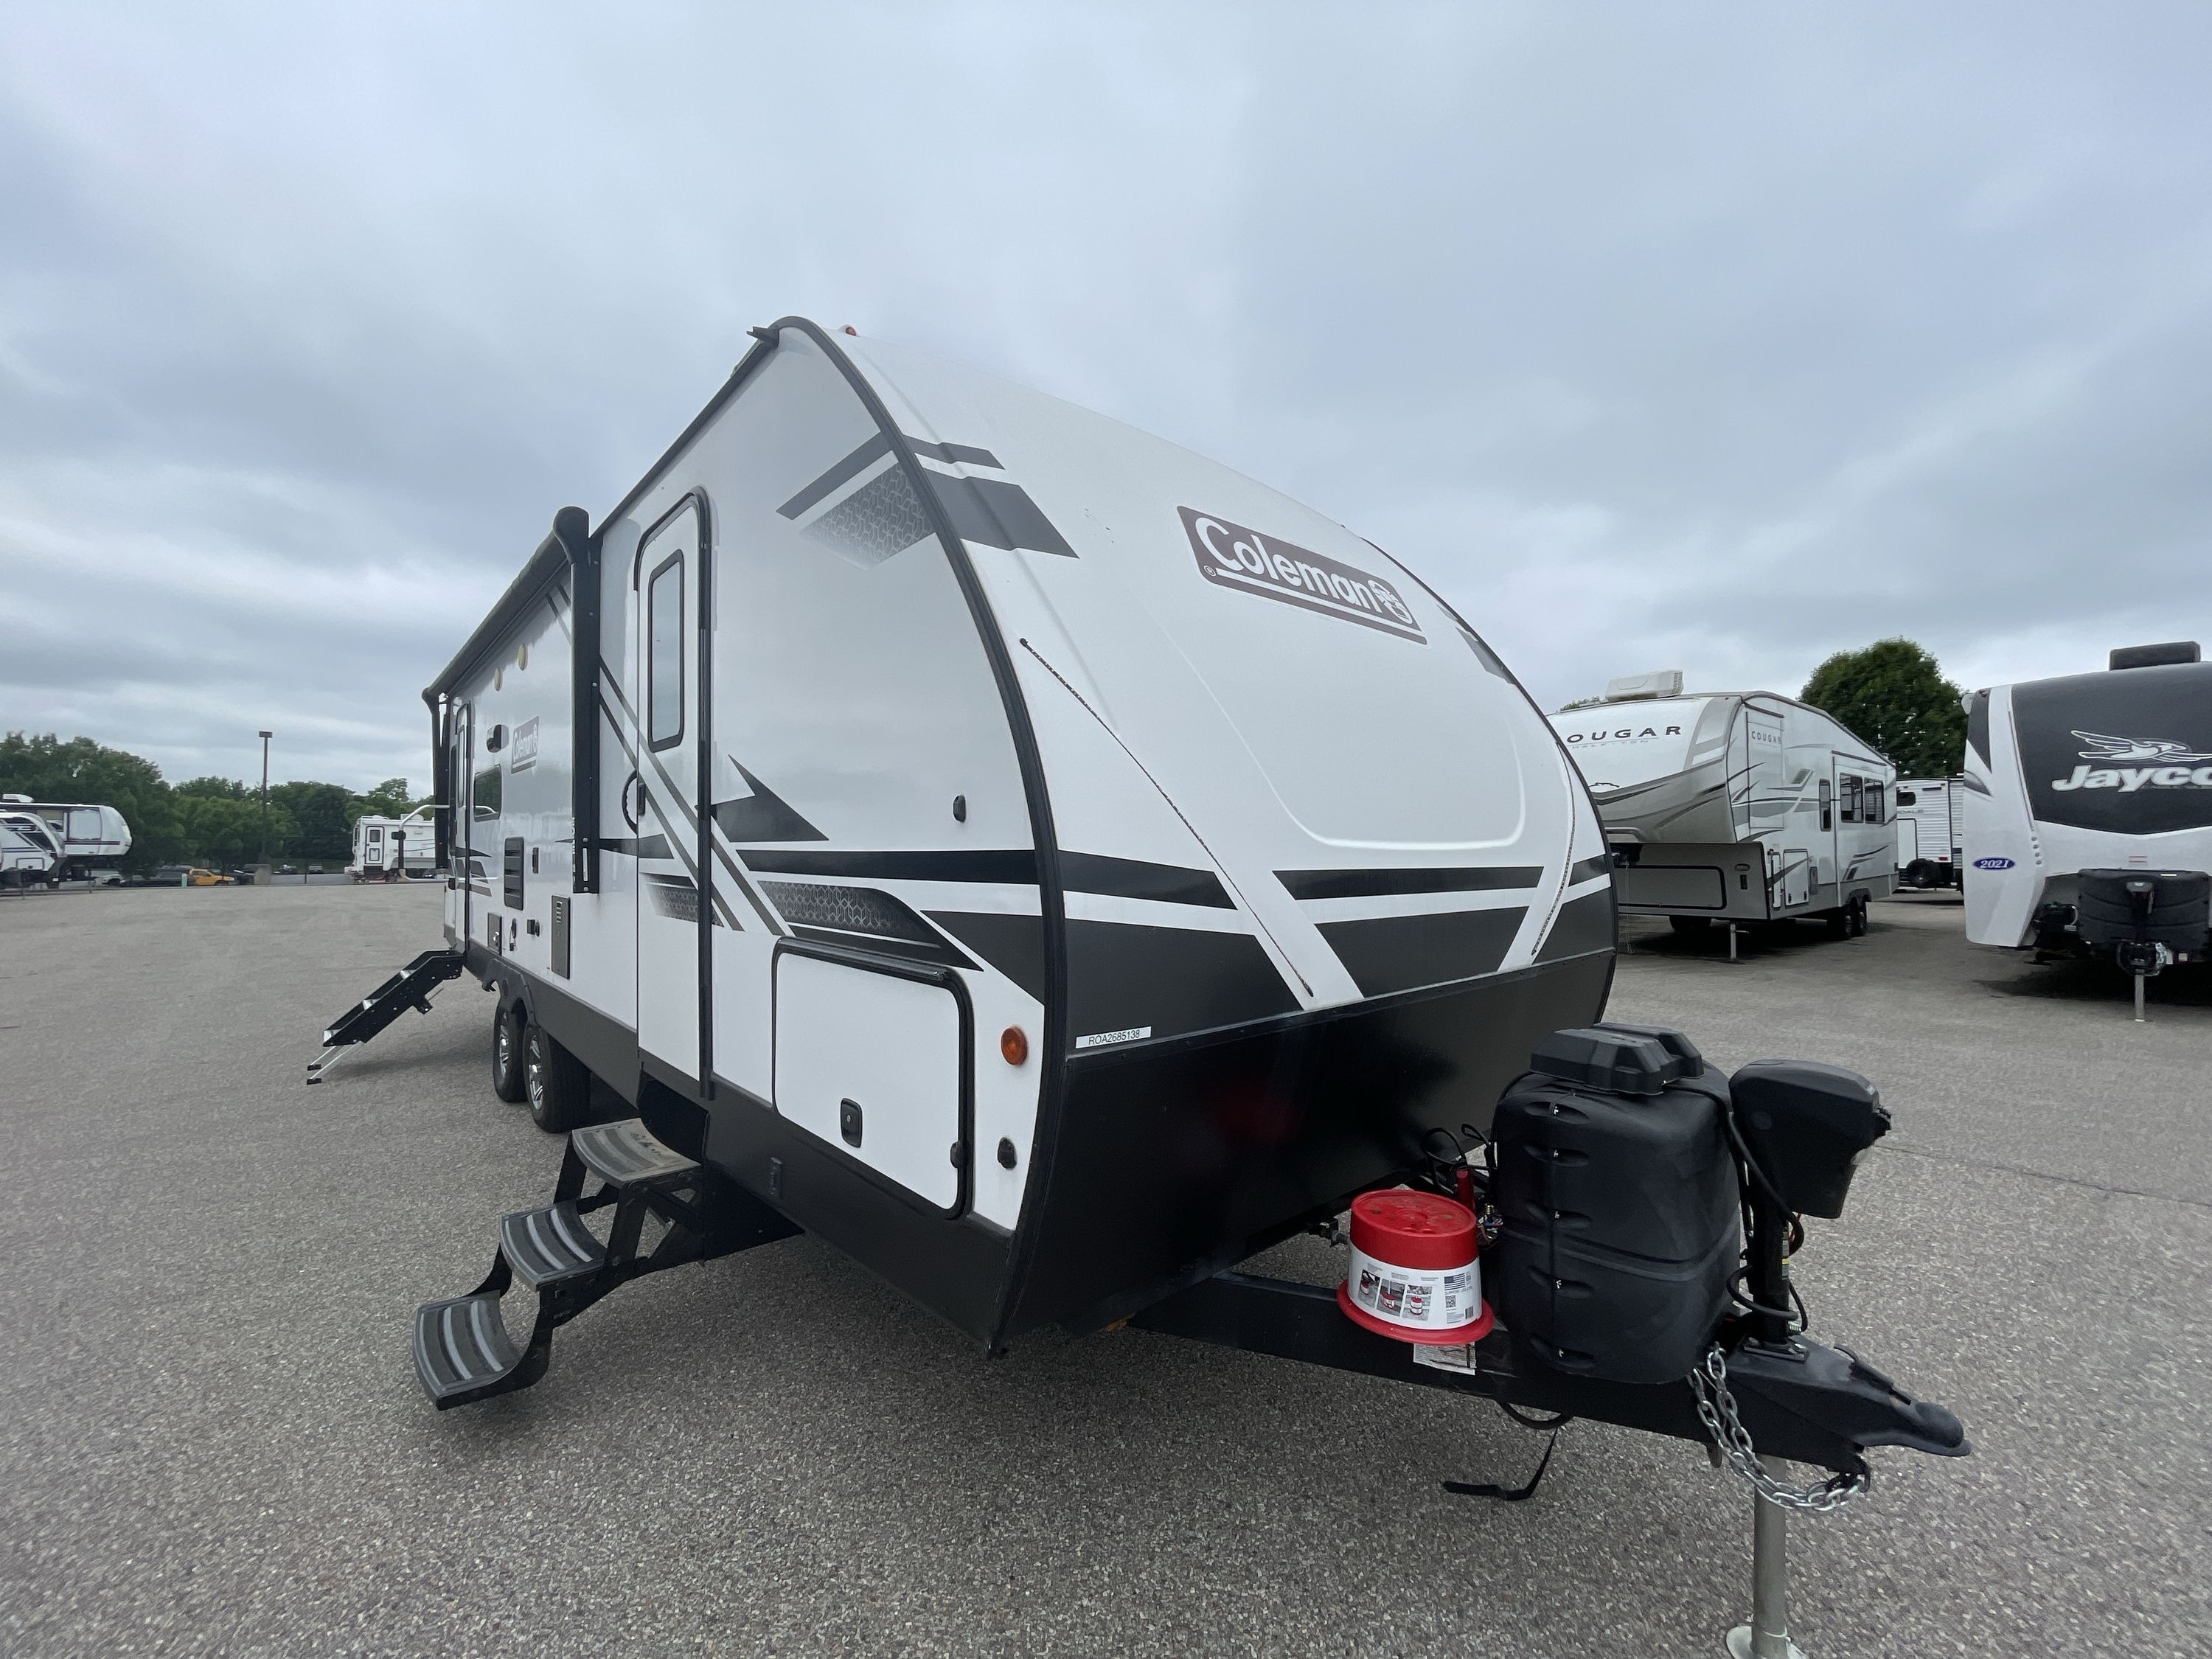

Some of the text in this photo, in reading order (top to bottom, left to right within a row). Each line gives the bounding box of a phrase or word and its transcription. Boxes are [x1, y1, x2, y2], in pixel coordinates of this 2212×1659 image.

[1195, 516, 1382, 613] Coleman
[1567, 726, 1681, 742] OUGAR
[1980, 860, 2008, 868] 2021
[1088, 1029, 1140, 1046] ROA2685138
